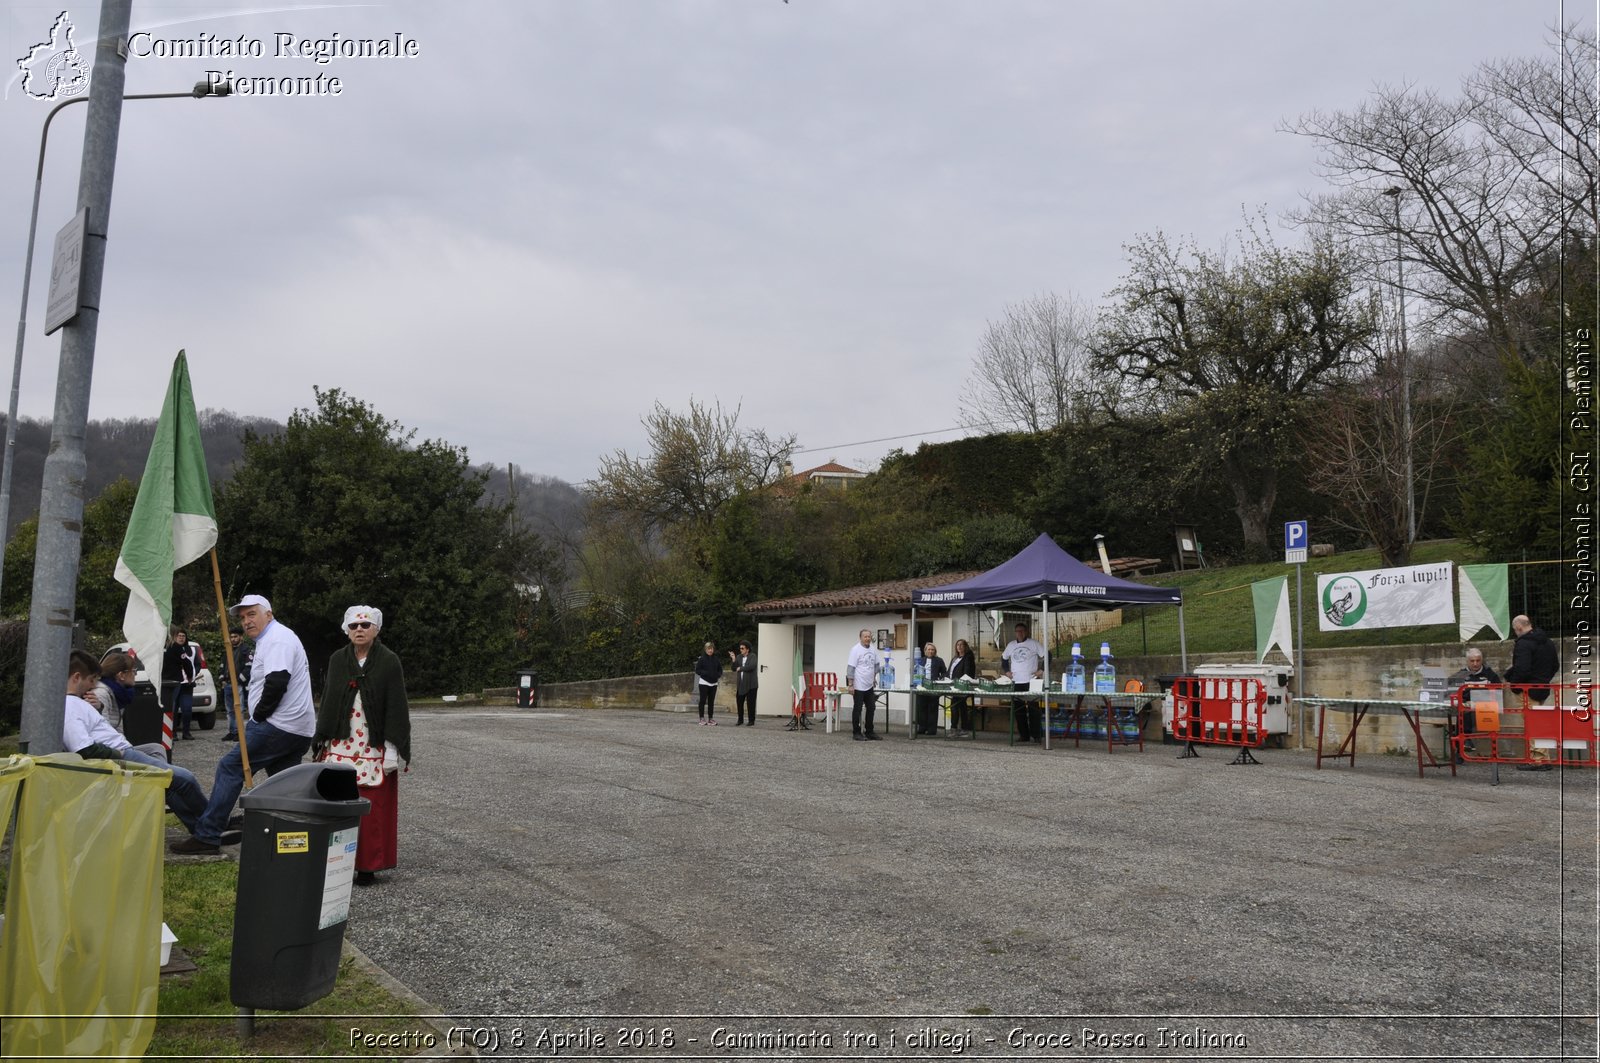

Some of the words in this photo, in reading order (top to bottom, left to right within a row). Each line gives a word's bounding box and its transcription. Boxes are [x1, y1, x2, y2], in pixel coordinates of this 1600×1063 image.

[1289, 524, 1303, 546] P
[1367, 573, 1405, 589] Forza
[1412, 567, 1448, 583] lupi!!
[1057, 585, 1068, 593] PRO
[1069, 586, 1083, 594] LOCO
[1084, 587, 1106, 595] PECETTO
